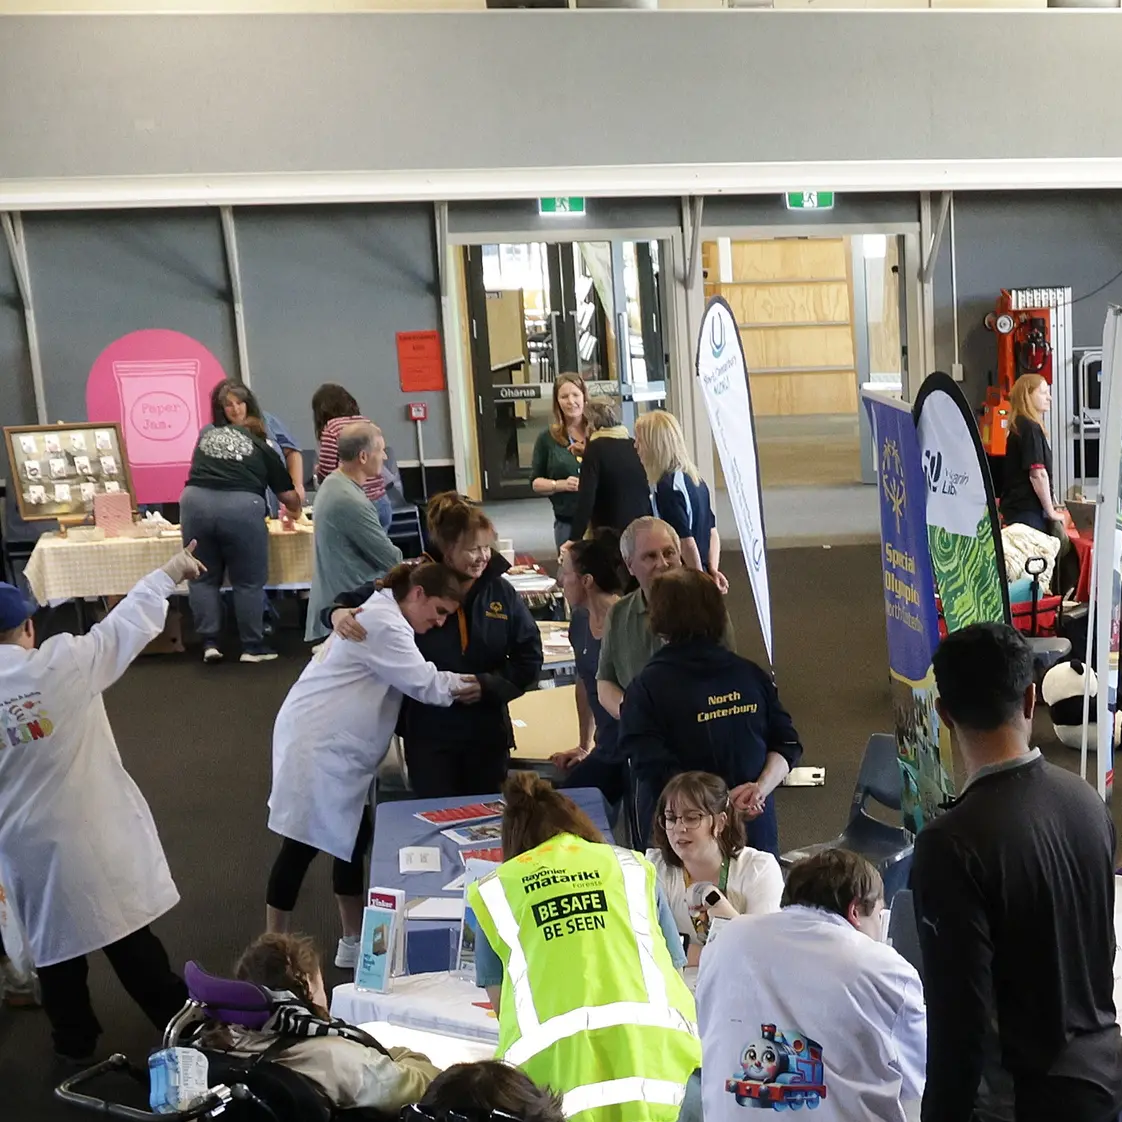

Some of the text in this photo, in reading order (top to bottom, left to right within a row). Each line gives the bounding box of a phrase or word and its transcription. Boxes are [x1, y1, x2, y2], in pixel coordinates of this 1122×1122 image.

[707, 690, 741, 706] North
[697, 703, 758, 723] Canterbury
[521, 868, 567, 884] Rayonier
[524, 870, 601, 895] matariki
[537, 893, 602, 922] BE SAFE
[543, 915, 606, 941] BE SEEN
